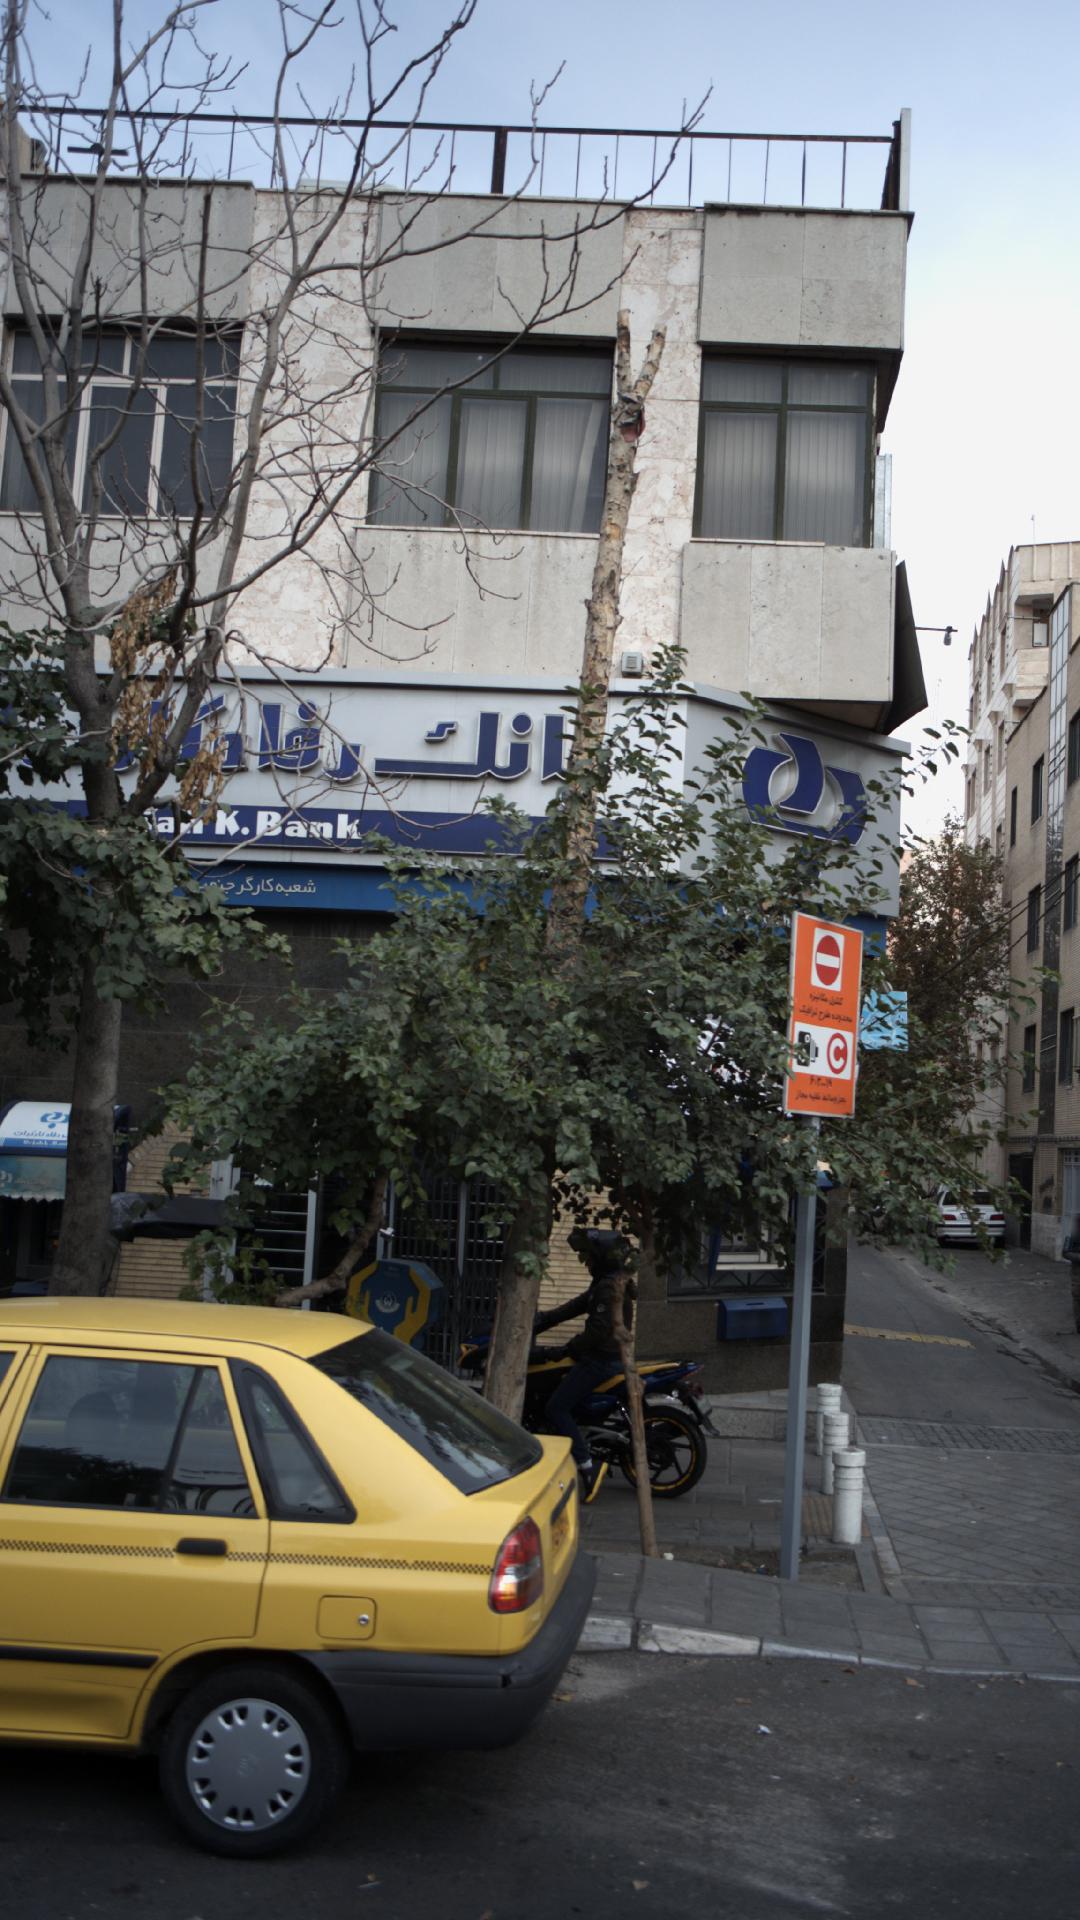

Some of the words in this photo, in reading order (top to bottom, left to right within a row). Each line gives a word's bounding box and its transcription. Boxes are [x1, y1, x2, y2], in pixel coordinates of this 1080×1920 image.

[256, 810, 362, 840] Bank
[235, 875, 274, 896] کارگر
[275, 879, 317, 897] شعبه
